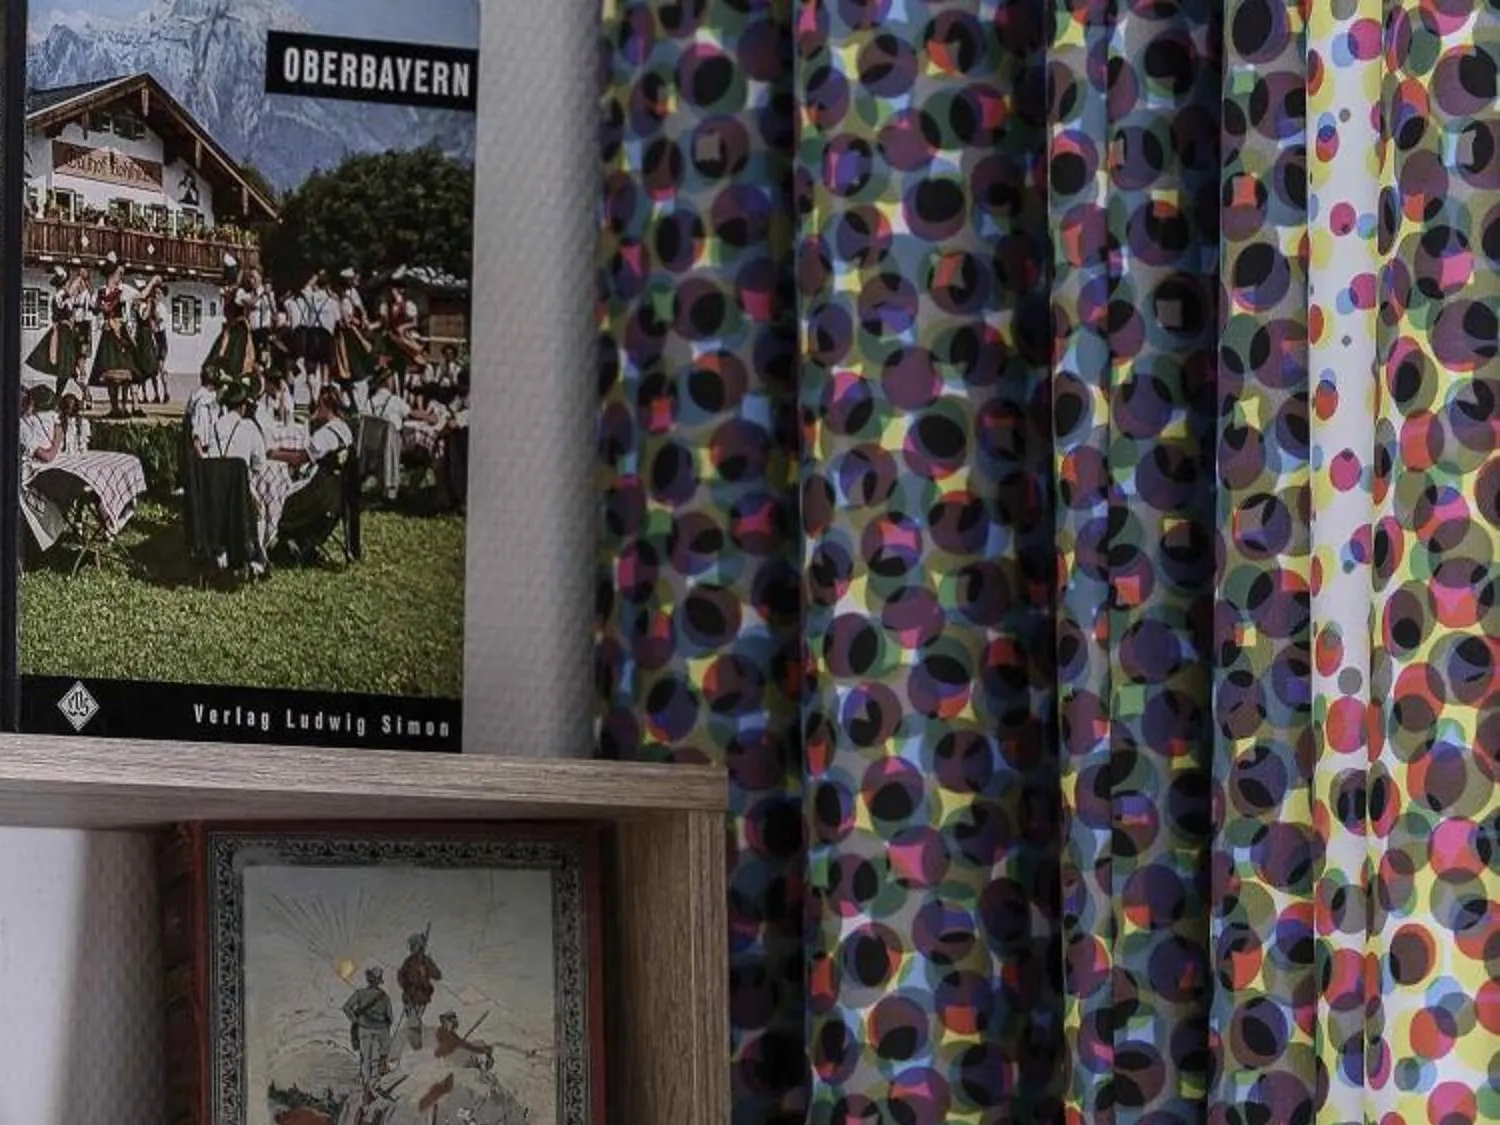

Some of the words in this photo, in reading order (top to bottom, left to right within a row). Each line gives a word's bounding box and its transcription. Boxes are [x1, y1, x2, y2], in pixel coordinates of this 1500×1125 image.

[282, 46, 471, 98] OBERBAYERN
[192, 702, 272, 732] Verlag
[286, 707, 367, 736] Ludwig
[381, 713, 450, 738] Simon
